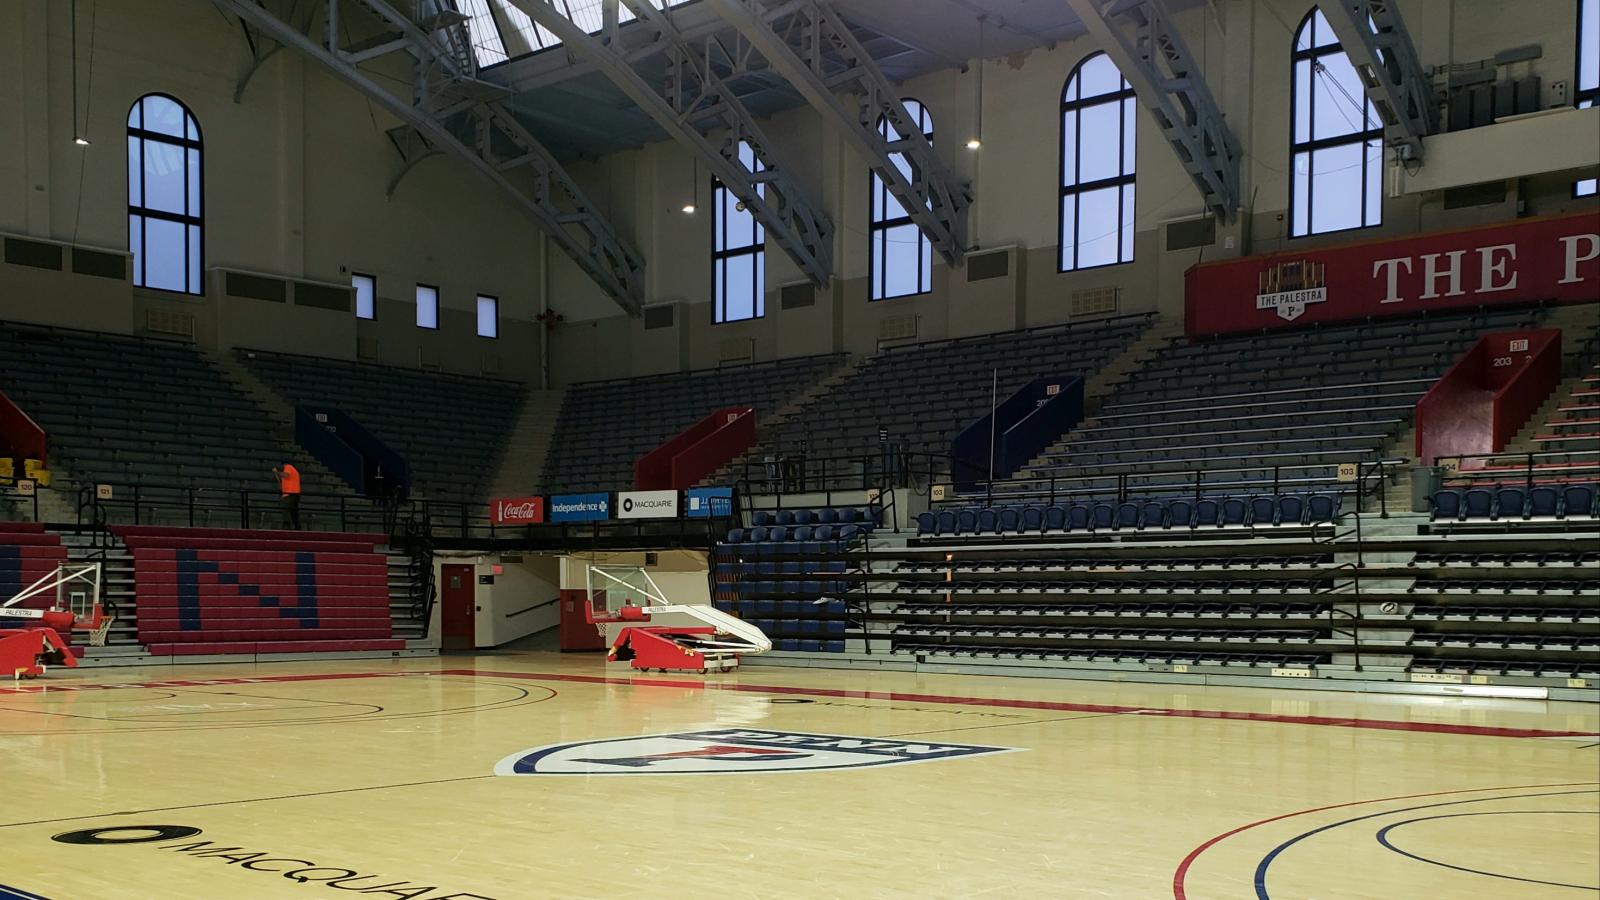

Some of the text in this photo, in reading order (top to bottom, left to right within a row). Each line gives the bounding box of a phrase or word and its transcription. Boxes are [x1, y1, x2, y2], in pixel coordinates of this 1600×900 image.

[1372, 243, 1518, 304] THE
[1260, 290, 1322, 306] THE PALESTRA
[1287, 306, 1296, 316] P
[1492, 356, 1512, 367] 203
[1340, 468, 1354, 476] 103
[552, 503, 598, 514] Independence
[634, 500, 672, 508] MACQUARIE
[702, 731, 975, 755] PENN
